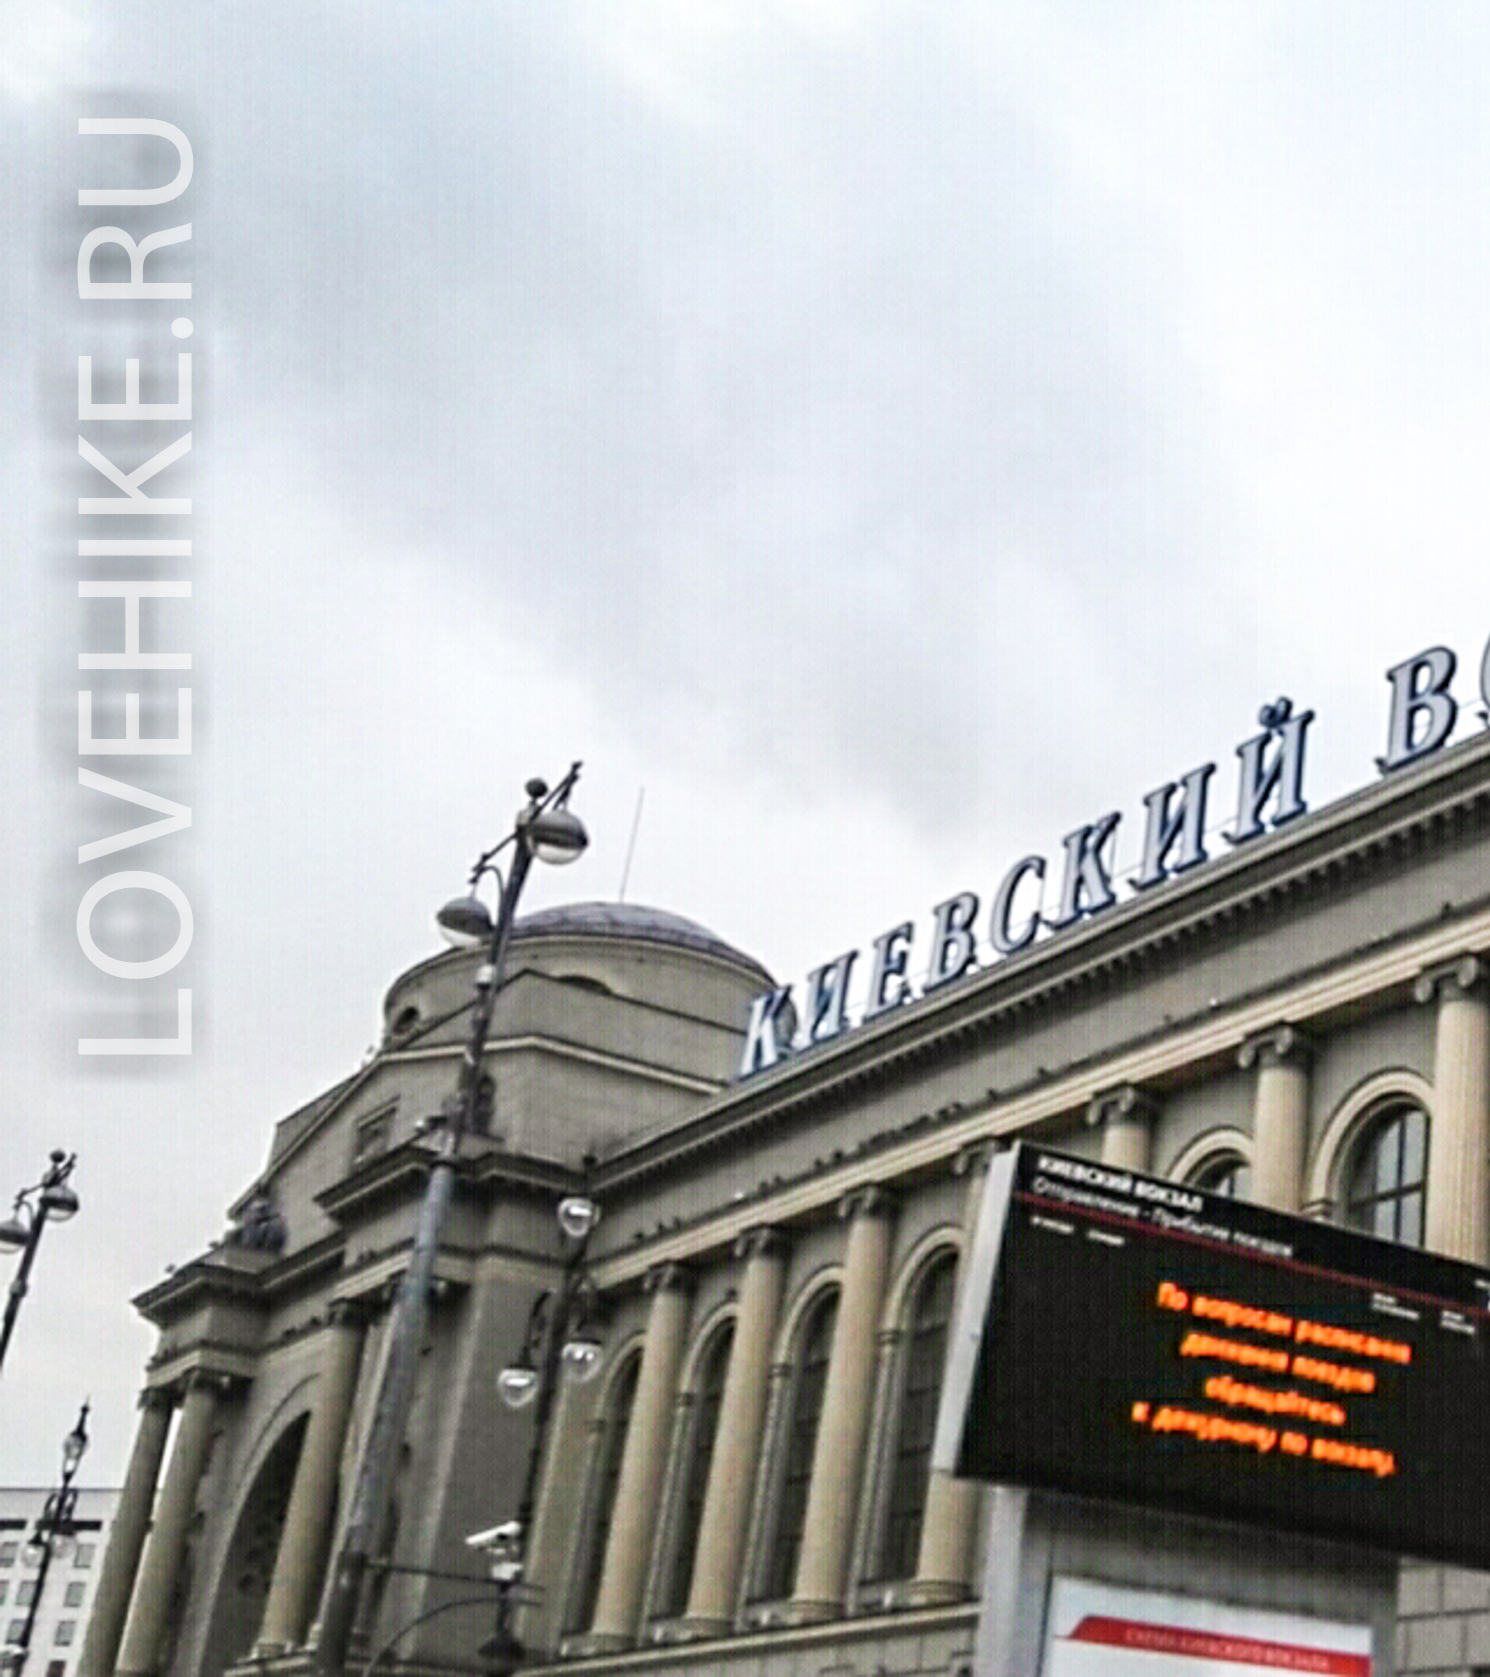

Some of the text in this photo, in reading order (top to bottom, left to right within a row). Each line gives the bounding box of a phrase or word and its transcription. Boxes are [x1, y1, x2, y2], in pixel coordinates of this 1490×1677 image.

[740, 697, 1316, 1080] КИЕВСКИЙ
[1134, 1180, 1204, 1212] ВОКЗАЛ
[1157, 1280, 1189, 1311] По
